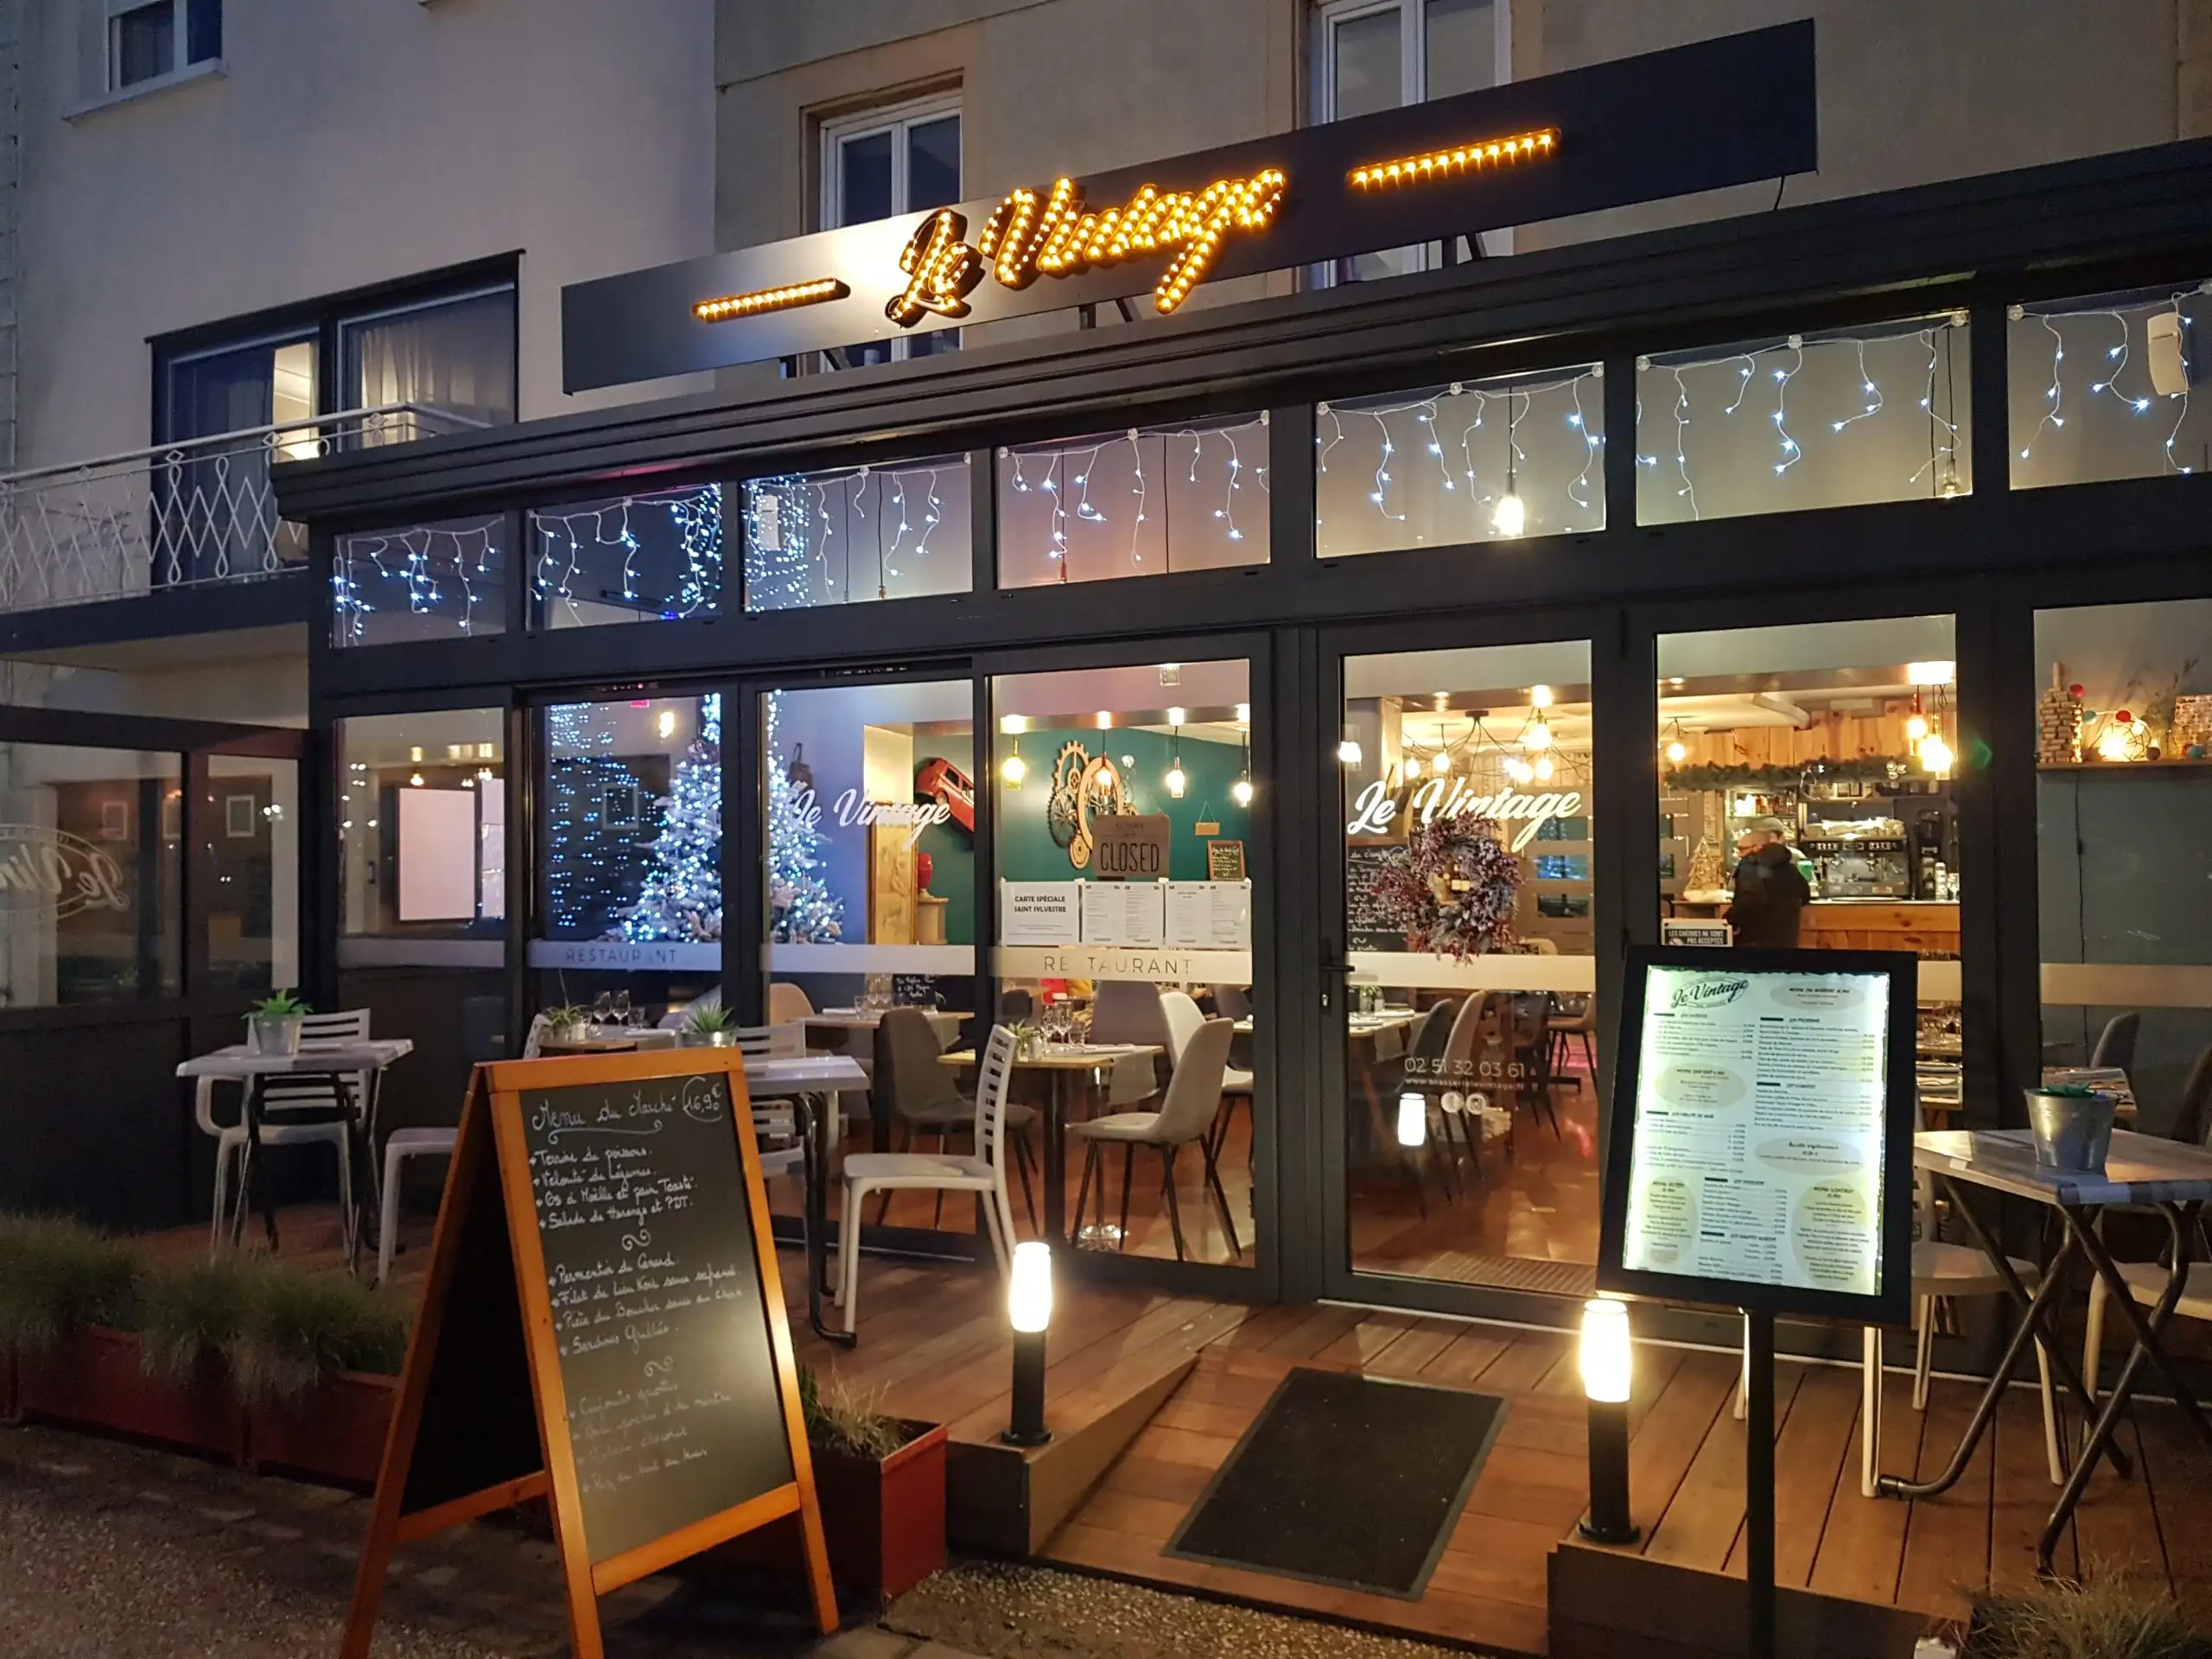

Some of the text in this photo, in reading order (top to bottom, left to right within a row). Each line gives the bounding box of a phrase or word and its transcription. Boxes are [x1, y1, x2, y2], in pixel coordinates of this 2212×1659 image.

[886, 168, 1287, 326] Le Vintage
[791, 788, 950, 851] Le Vintage
[1347, 776, 1582, 853] Le Vintage
[1100, 842, 1160, 873] CLOSED
[1044, 955, 1193, 975] RETAURANT
[1670, 979, 1750, 1008] Le Vintage
[1404, 1057, 1525, 1078] 02 51 32 03 61
[531, 1098, 586, 1130] Menu
[596, 1099, 622, 1122] du
[628, 1089, 677, 1116] Marché
[582, 1146, 600, 1163] de
[542, 1169, 586, 1187] Velouté
[588, 1166, 606, 1183] de
[589, 1208, 605, 1223] de
